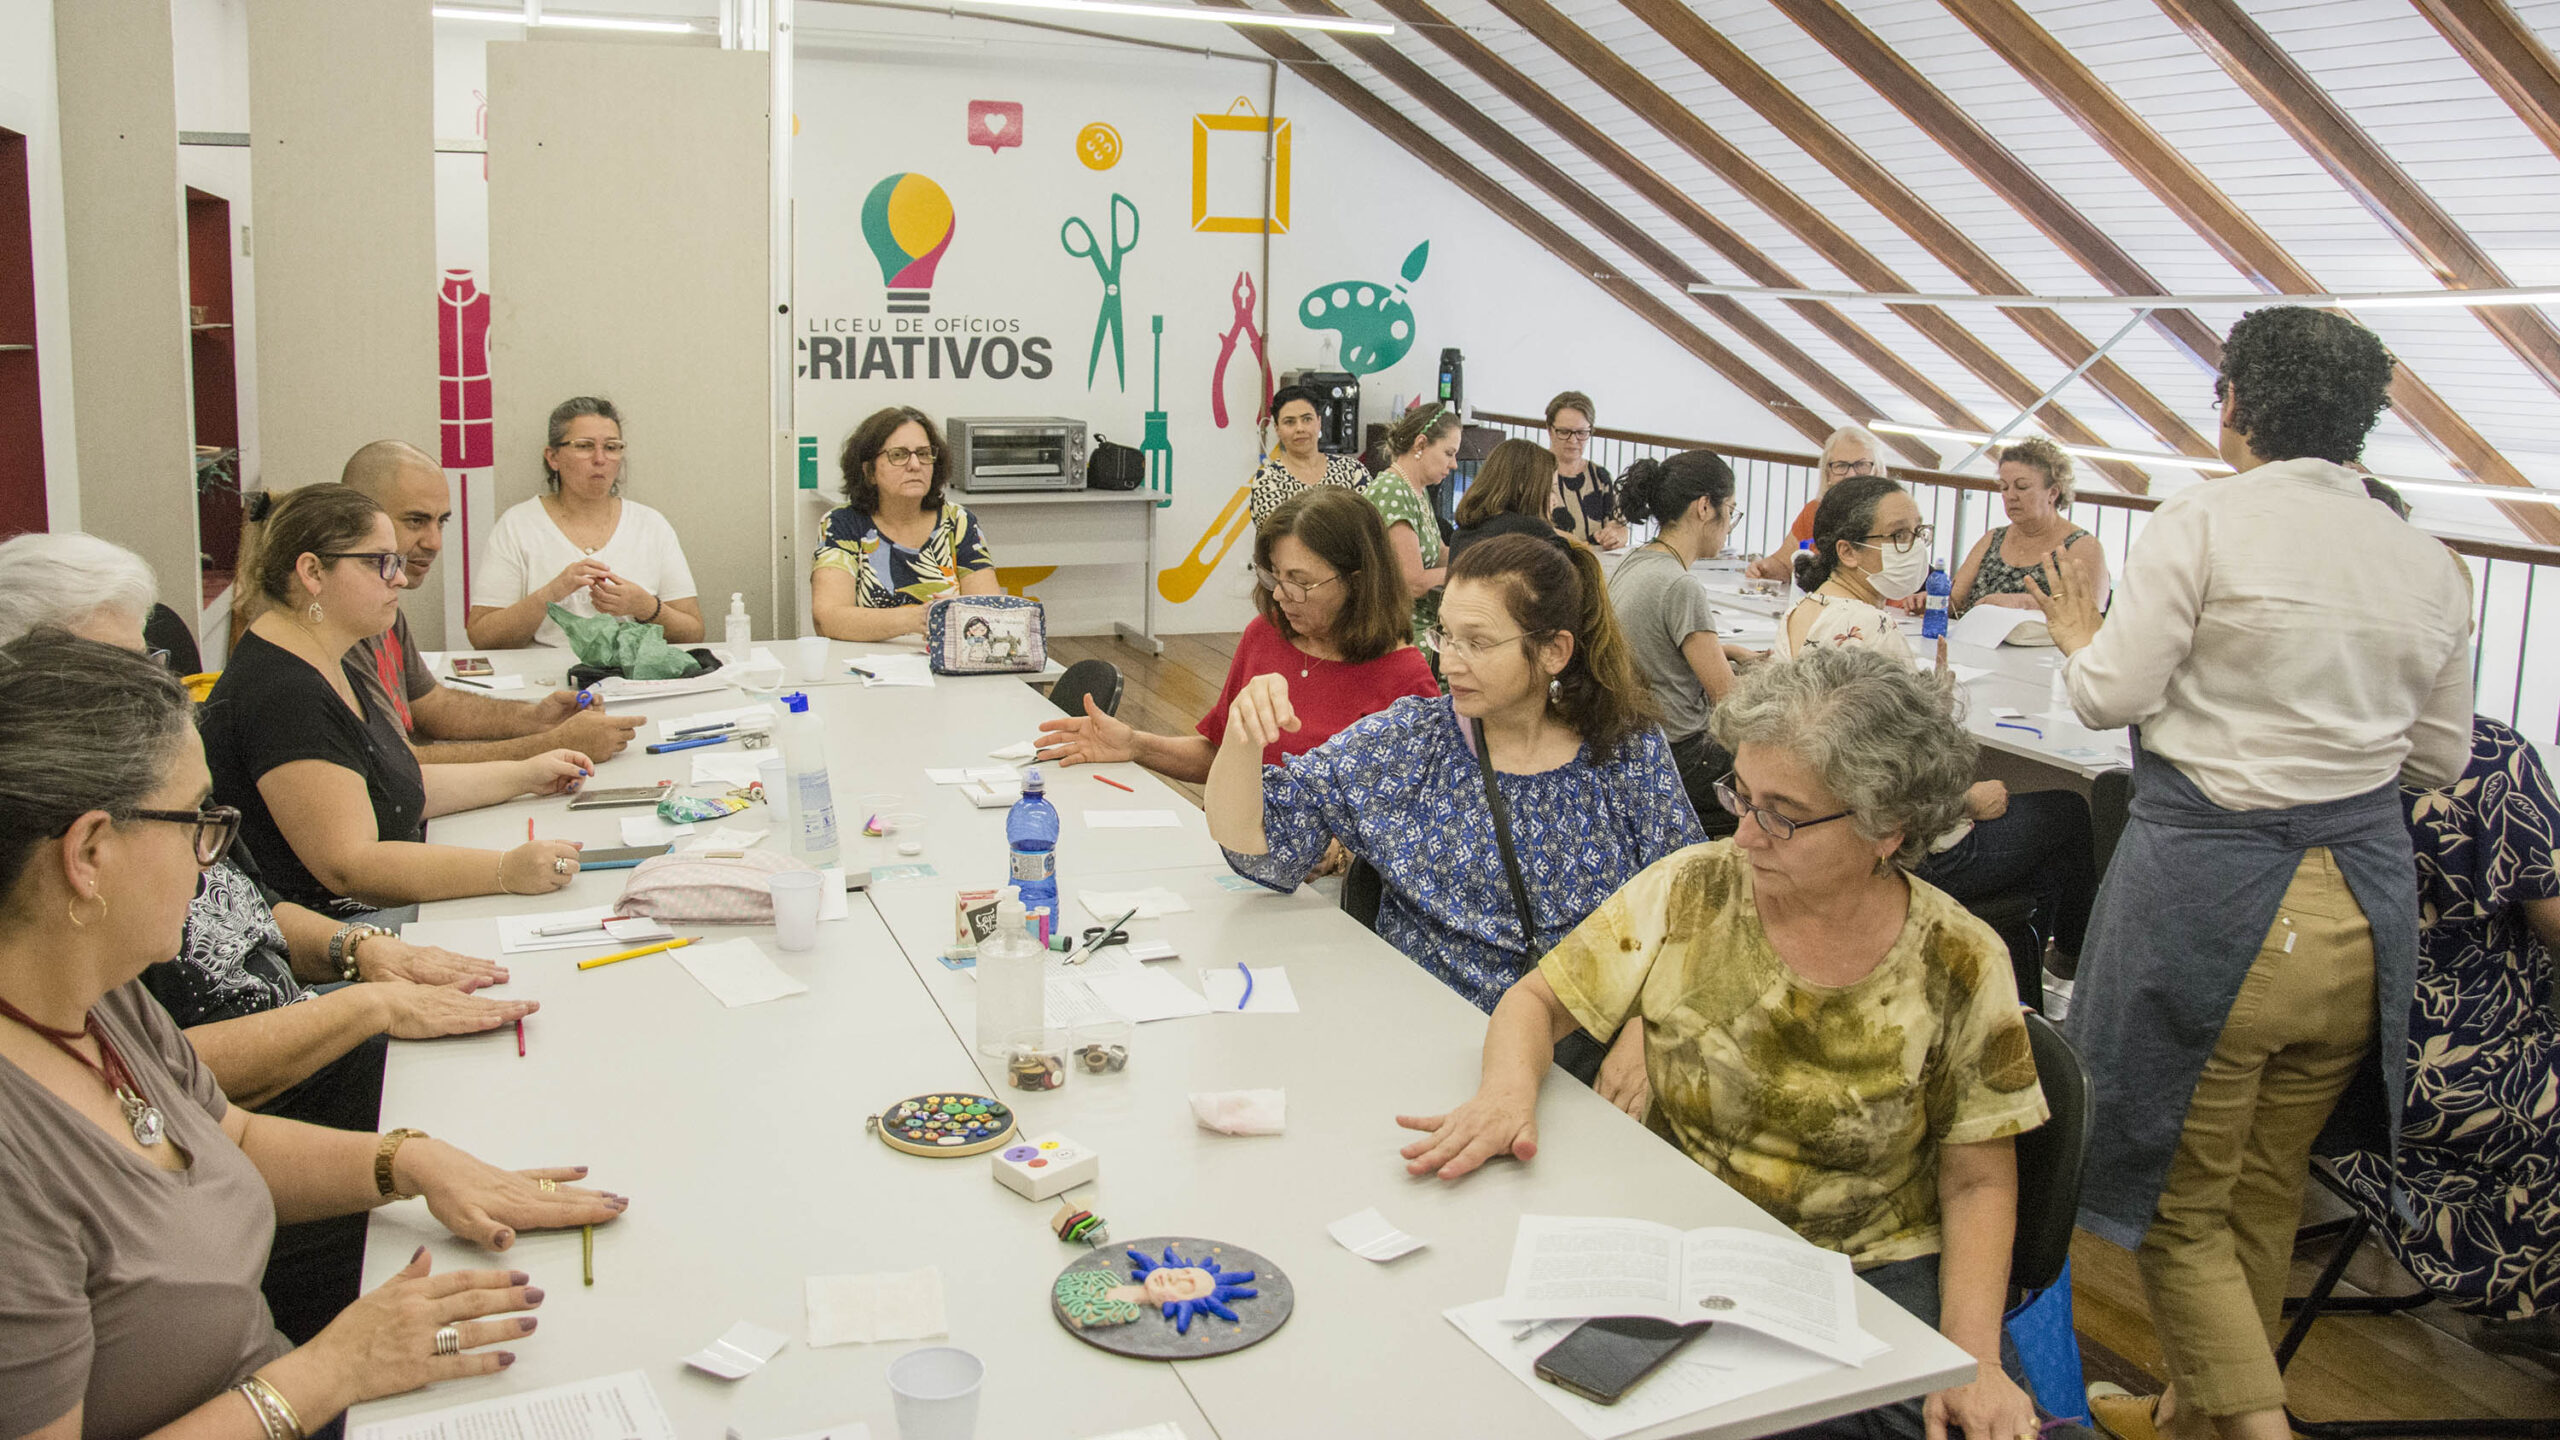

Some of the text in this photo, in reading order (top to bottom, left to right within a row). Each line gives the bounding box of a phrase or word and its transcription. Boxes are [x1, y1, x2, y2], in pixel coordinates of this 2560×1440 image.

[810, 315, 1020, 333] LICEU DE OFÍCIOS
